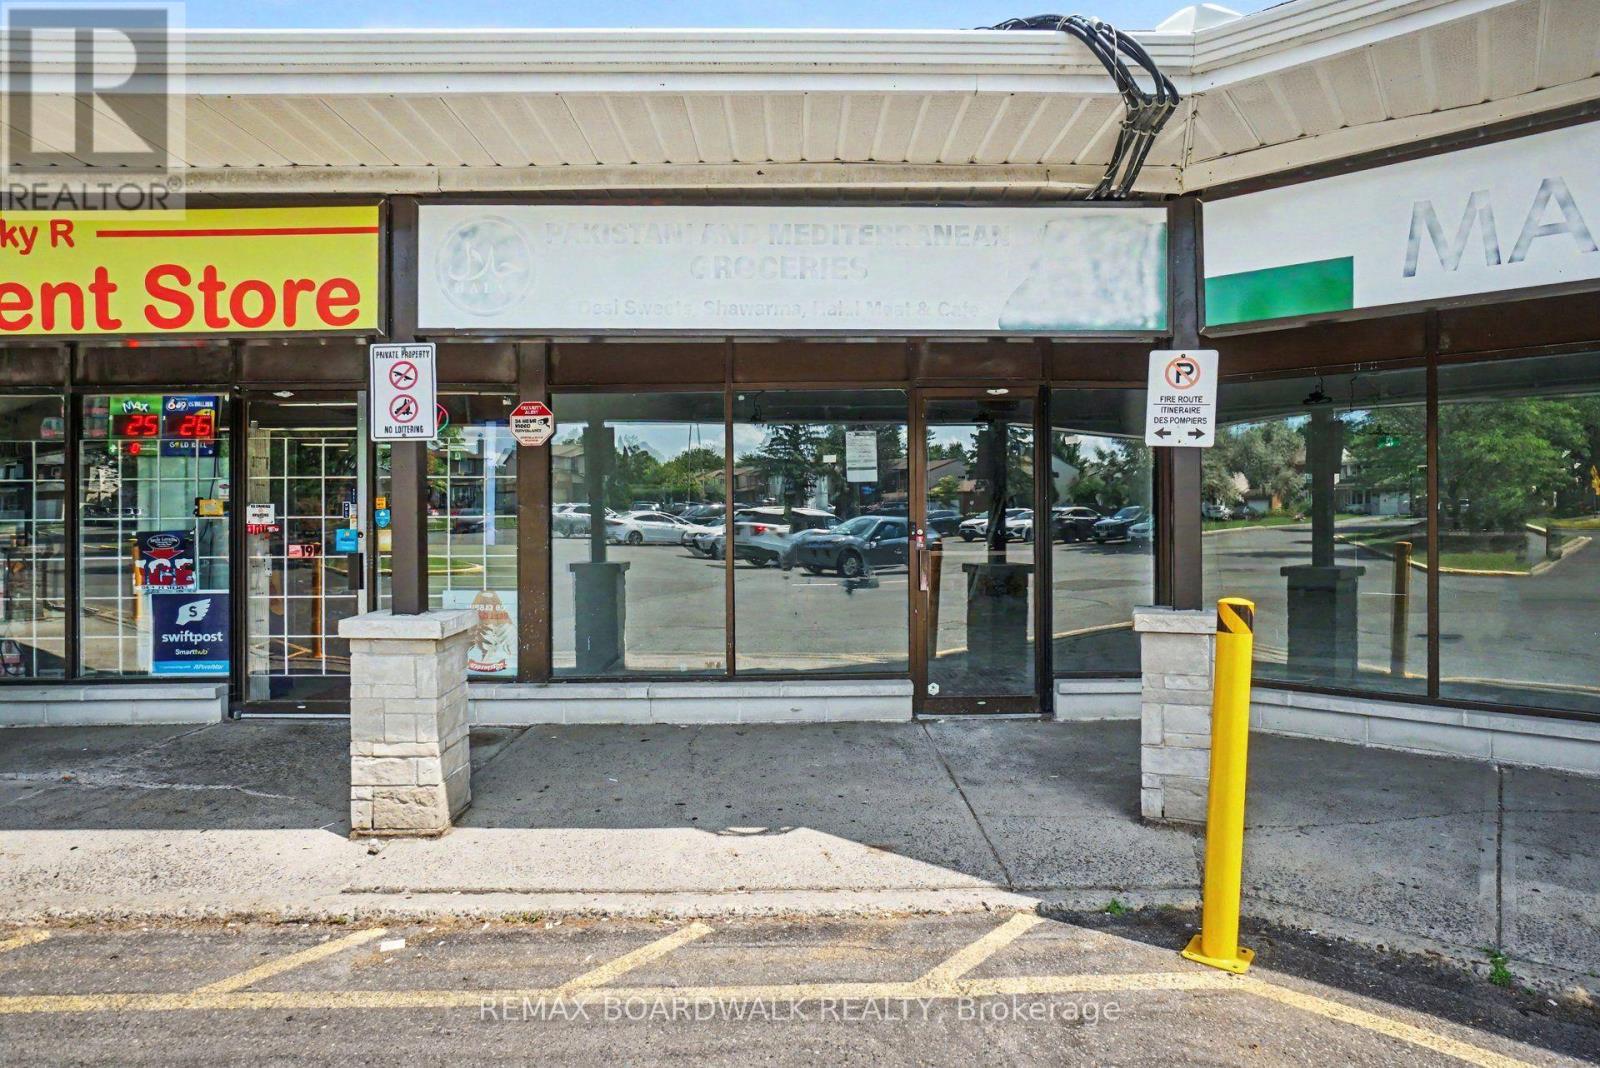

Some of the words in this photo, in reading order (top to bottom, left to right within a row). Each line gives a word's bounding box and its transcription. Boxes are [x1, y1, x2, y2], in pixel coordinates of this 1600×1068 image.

[50, 218, 75, 248] R
[768, 223, 1010, 247] MEDITERRANEAN
[1402, 176, 1599, 278] MA
[690, 254, 869, 281] GROCERIES
[0, 266, 122, 331] ent
[144, 264, 361, 330] Store
[577, 298, 620, 316] Desi
[704, 299, 807, 320] Shawarma,
[918, 300, 931, 316] &
[402, 350, 430, 358] PROPERTY
[1160, 395, 1175, 403] FIRE
[1178, 395, 1203, 403] ROUTE
[127, 415, 158, 436] 25
[180, 415, 211, 436] 26
[1169, 416, 1207, 425] POMPIERS
[189, 605, 198, 618] S
[161, 630, 224, 645] swiftpost
